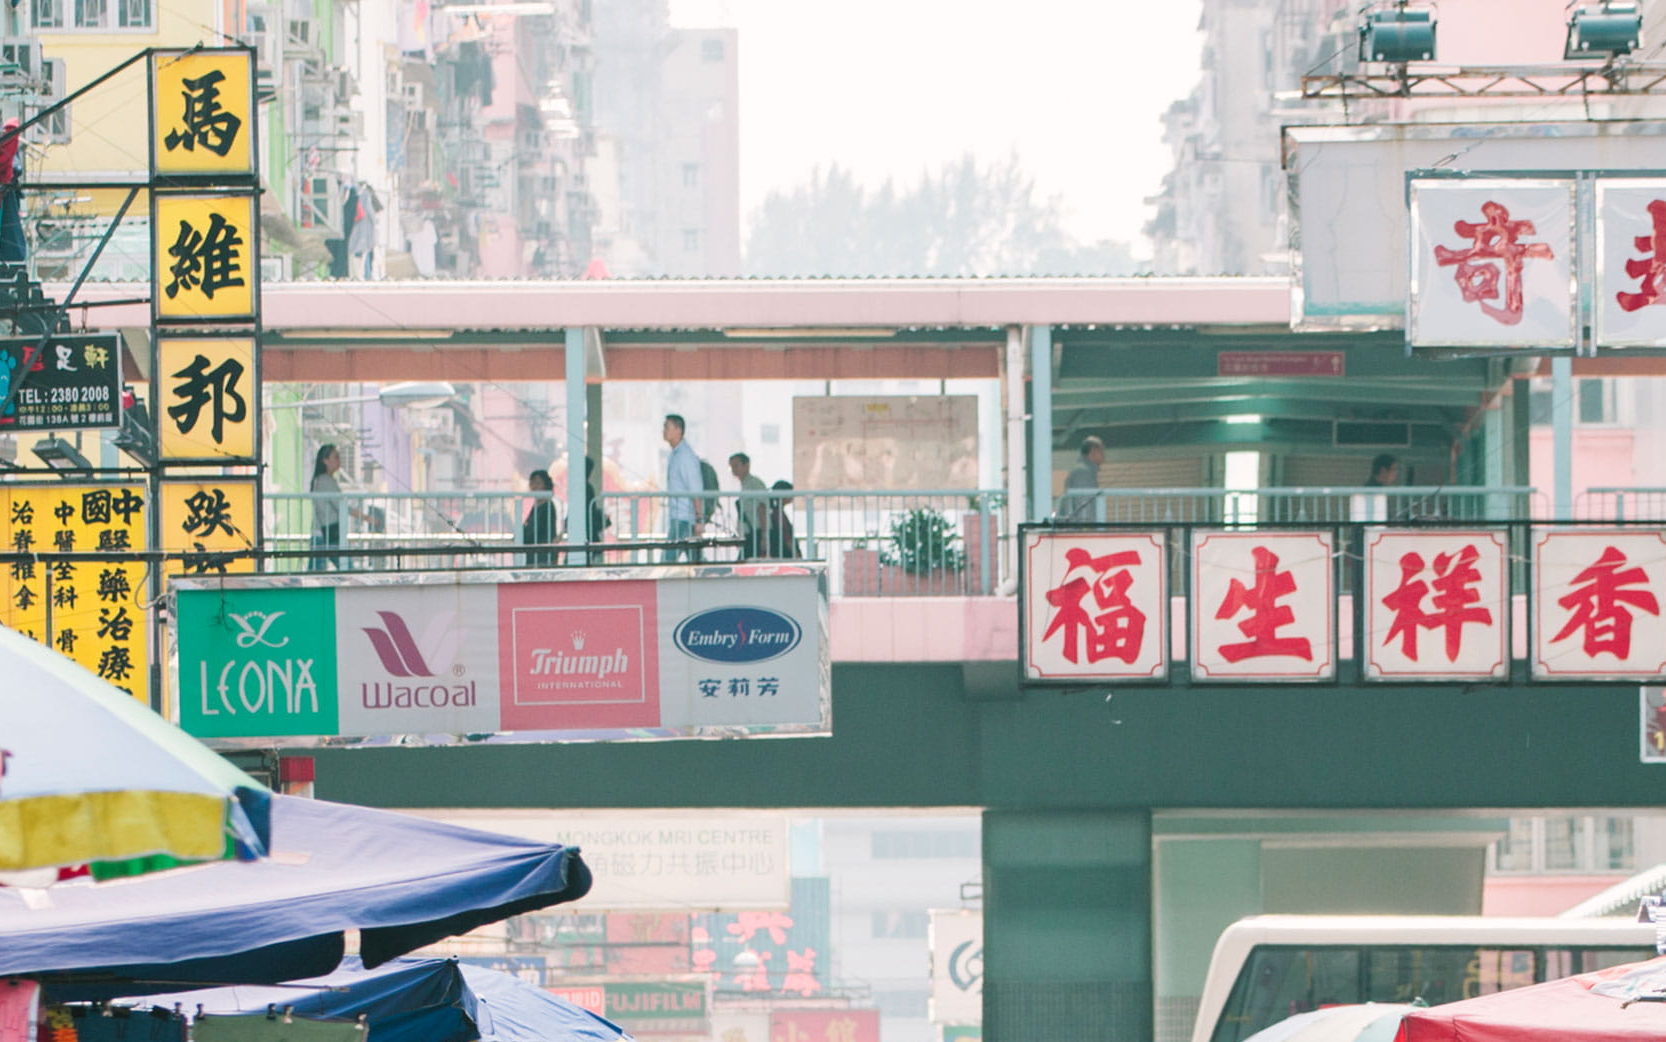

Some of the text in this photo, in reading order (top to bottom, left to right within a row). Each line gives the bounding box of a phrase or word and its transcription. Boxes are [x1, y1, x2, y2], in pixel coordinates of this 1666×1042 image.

[18, 385, 110, 404] TEL: 2380 2008
[95, 529, 134, 696] 醫藥治療
[56, 628, 79, 662] 骨
[688, 628, 790, 649] Embry Form
[530, 648, 628, 678] Triumph
[200, 658, 318, 715] LEONA
[362, 680, 477, 709] Wacoal
[537, 680, 623, 689] INTERNATIONAL
[698, 676, 780, 698] 安莉芳
[556, 829, 774, 846] MONGKOK MRI CENTRE
[605, 992, 702, 1012] FUJIFILM
